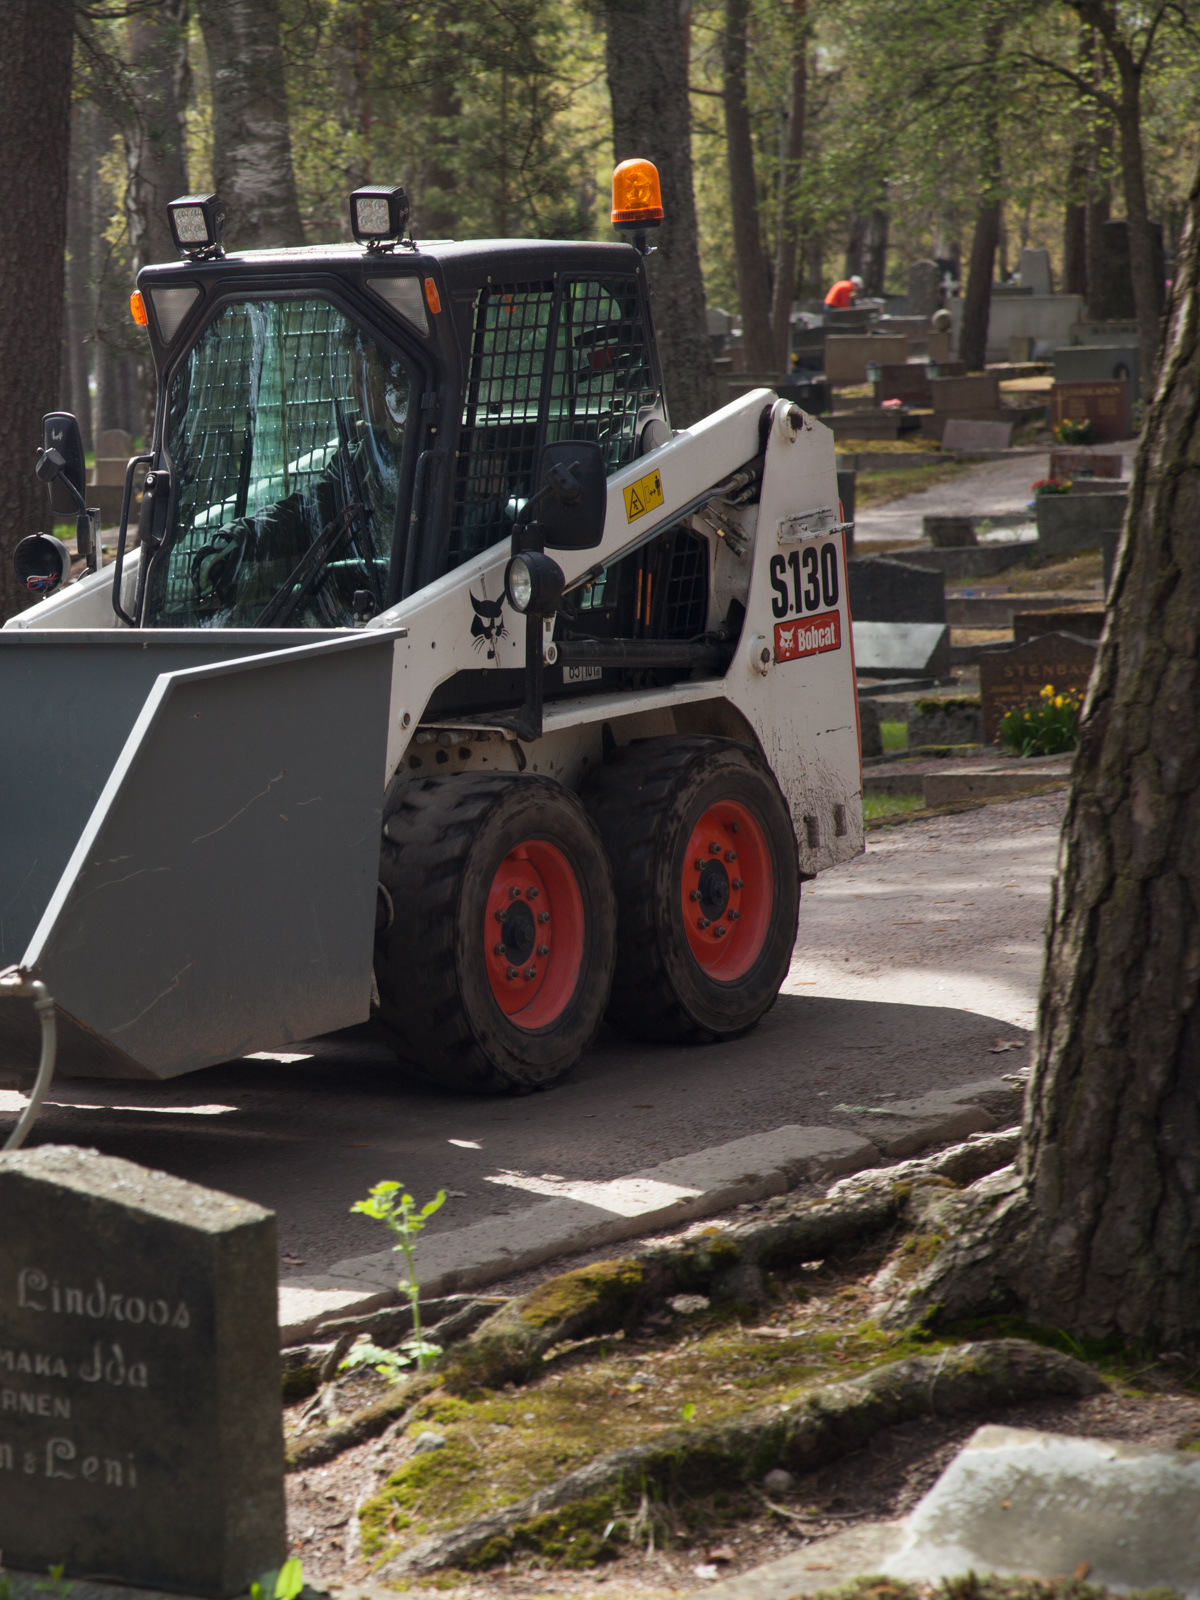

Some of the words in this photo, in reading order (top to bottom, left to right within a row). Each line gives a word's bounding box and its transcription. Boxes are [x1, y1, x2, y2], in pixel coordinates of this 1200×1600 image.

[798, 622, 836, 652] Bobcat
[16, 1267, 192, 1330] Lindroos
[44, 1436, 138, 1489] Leni
